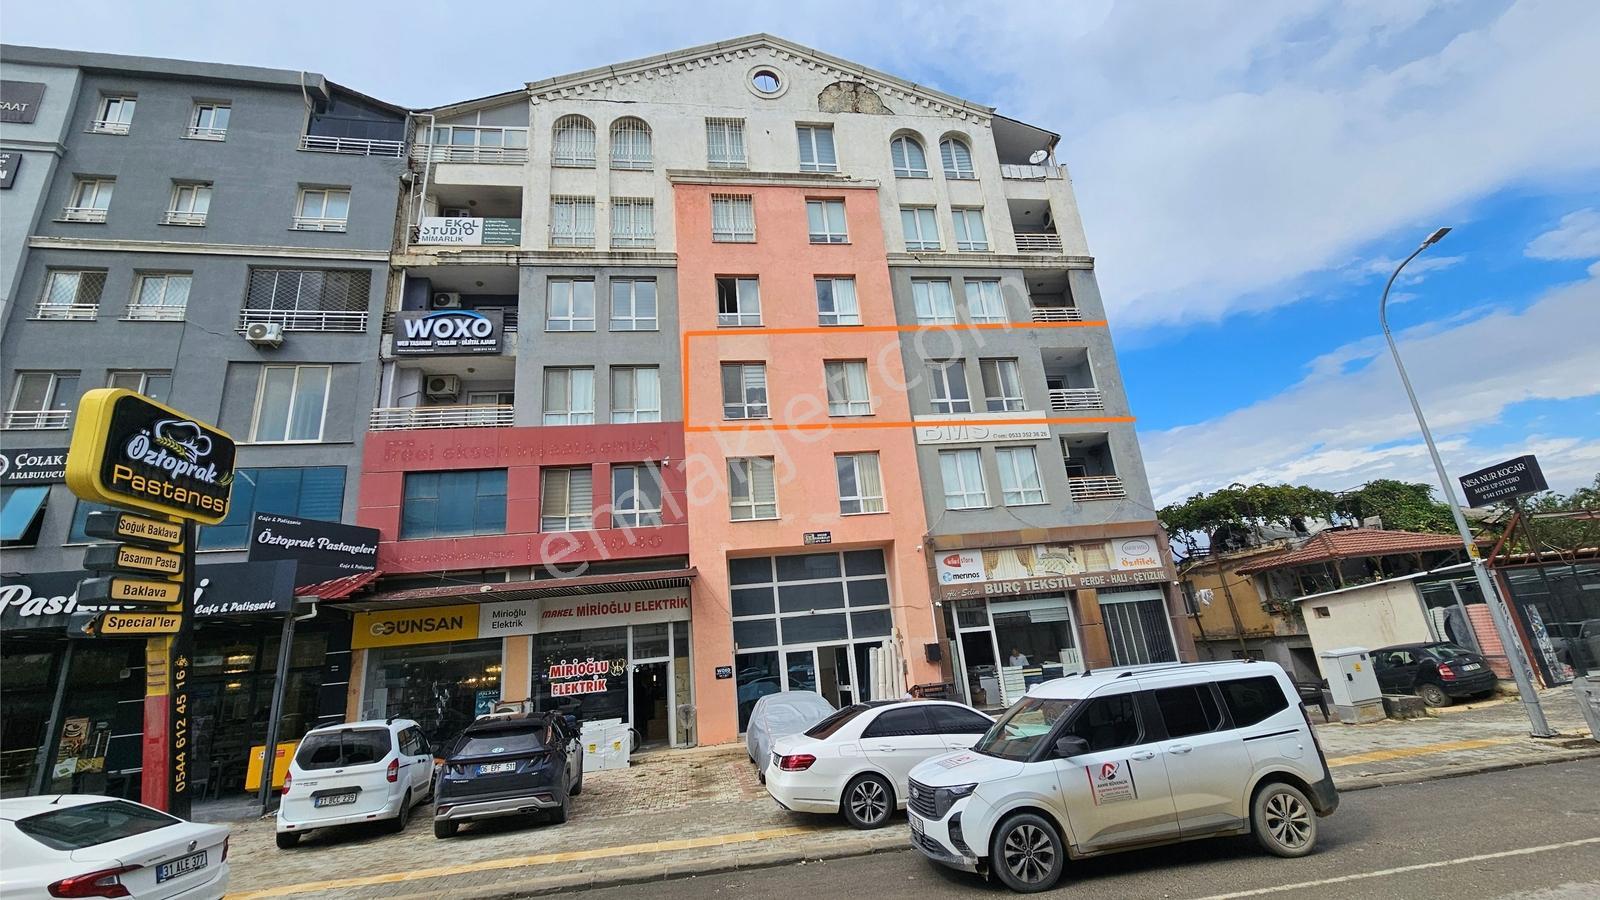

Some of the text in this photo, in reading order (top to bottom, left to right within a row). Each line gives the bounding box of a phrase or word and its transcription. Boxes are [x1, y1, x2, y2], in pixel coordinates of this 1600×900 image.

[403, 318, 493, 338] WOXO
[14, 452, 64, 470] ÇOLAK
[127, 429, 218, 484] Öztoprak
[112, 463, 231, 513] Pastanesi
[119, 519, 178, 539] Soğuk Baklava
[258, 528, 378, 554] Öztoprak Pastaneleri
[120, 550, 177, 569] Tasarım Pasta
[123, 584, 167, 598] Baklava
[984, 581, 1021, 595] BURÇ
[1024, 575, 1076, 590] TEKSTİL
[1080, 575, 1106, 586] PERDE
[1110, 573, 1127, 584] HALI
[194, 600, 276, 616] Cafe & Patisserie
[492, 607, 527, 621] Mirioğlu
[576, 602, 632, 617] MİRİOĞLU
[634, 596, 689, 613] ELEKTRİK
[108, 616, 177, 629] Special'ler
[491, 618, 524, 629] Elektrik
[175, 670, 187, 793] 0544 612 45 16
[163, 854, 205, 877] 31 ALE 377
